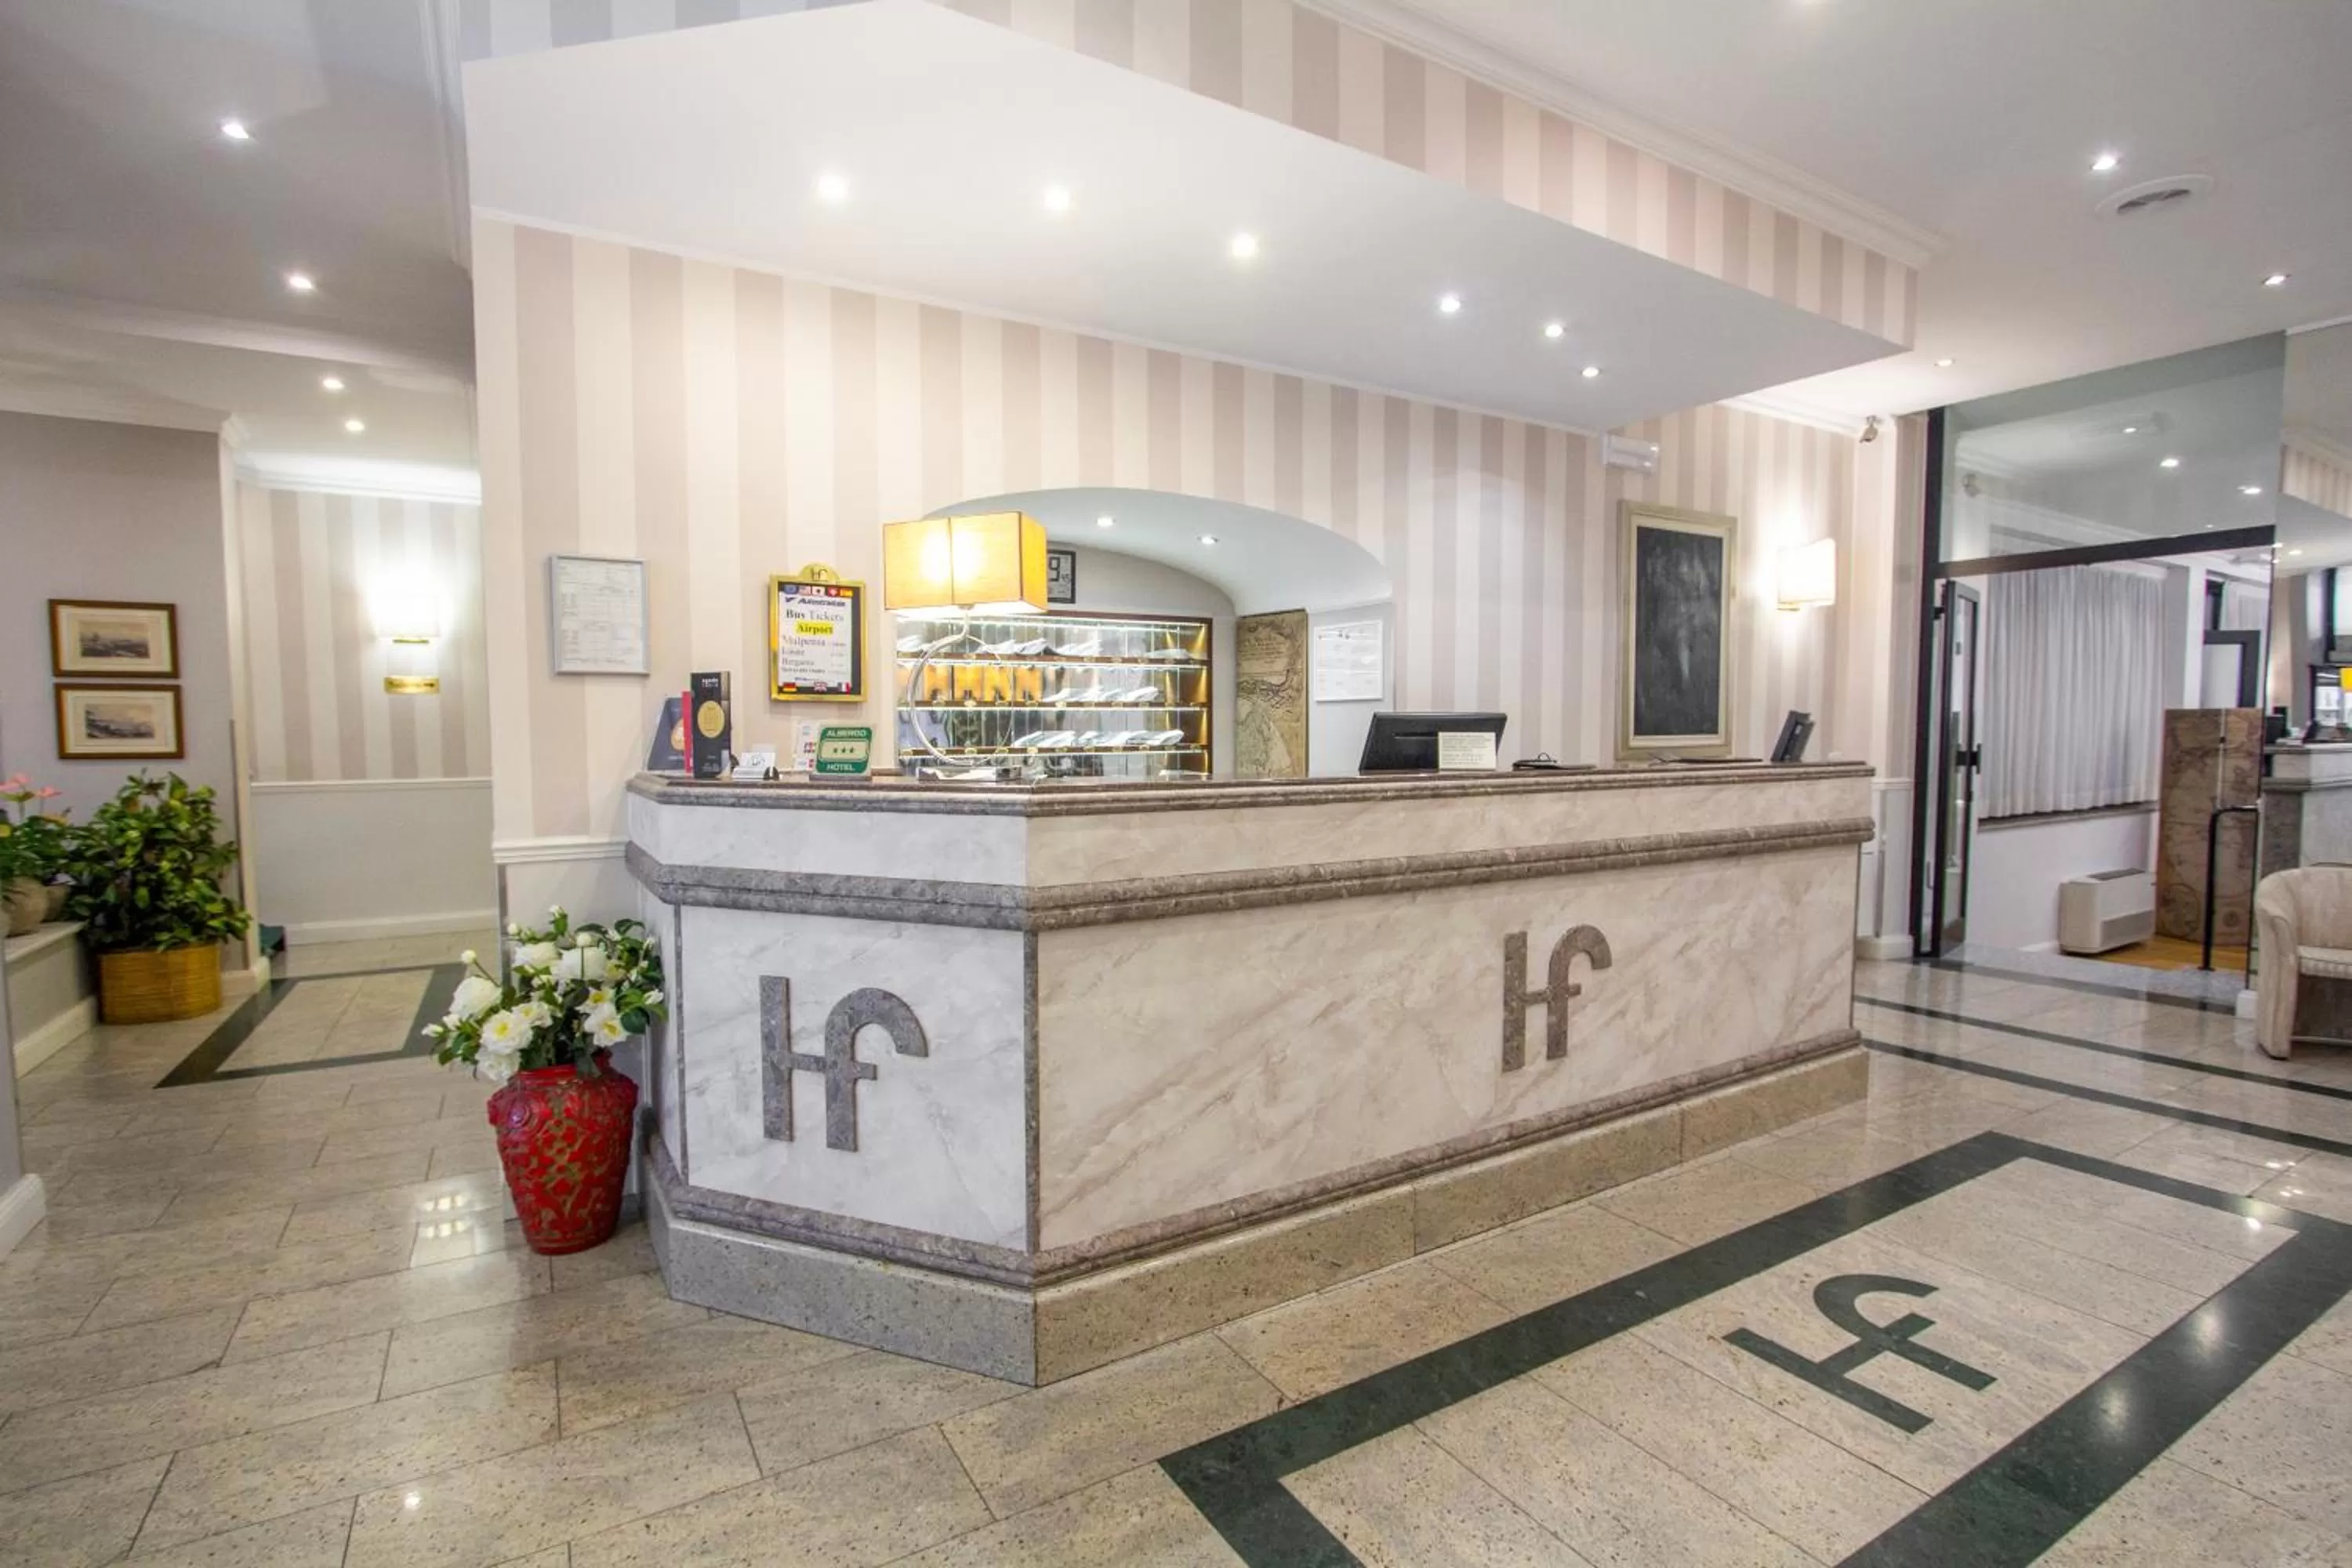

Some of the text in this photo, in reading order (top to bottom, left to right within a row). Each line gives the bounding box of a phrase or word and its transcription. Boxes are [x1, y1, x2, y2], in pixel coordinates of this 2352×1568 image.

[786, 608, 844, 622] Bus Tickets
[797, 624, 833, 636] Airport
[826, 763, 855, 771] HOTEL
